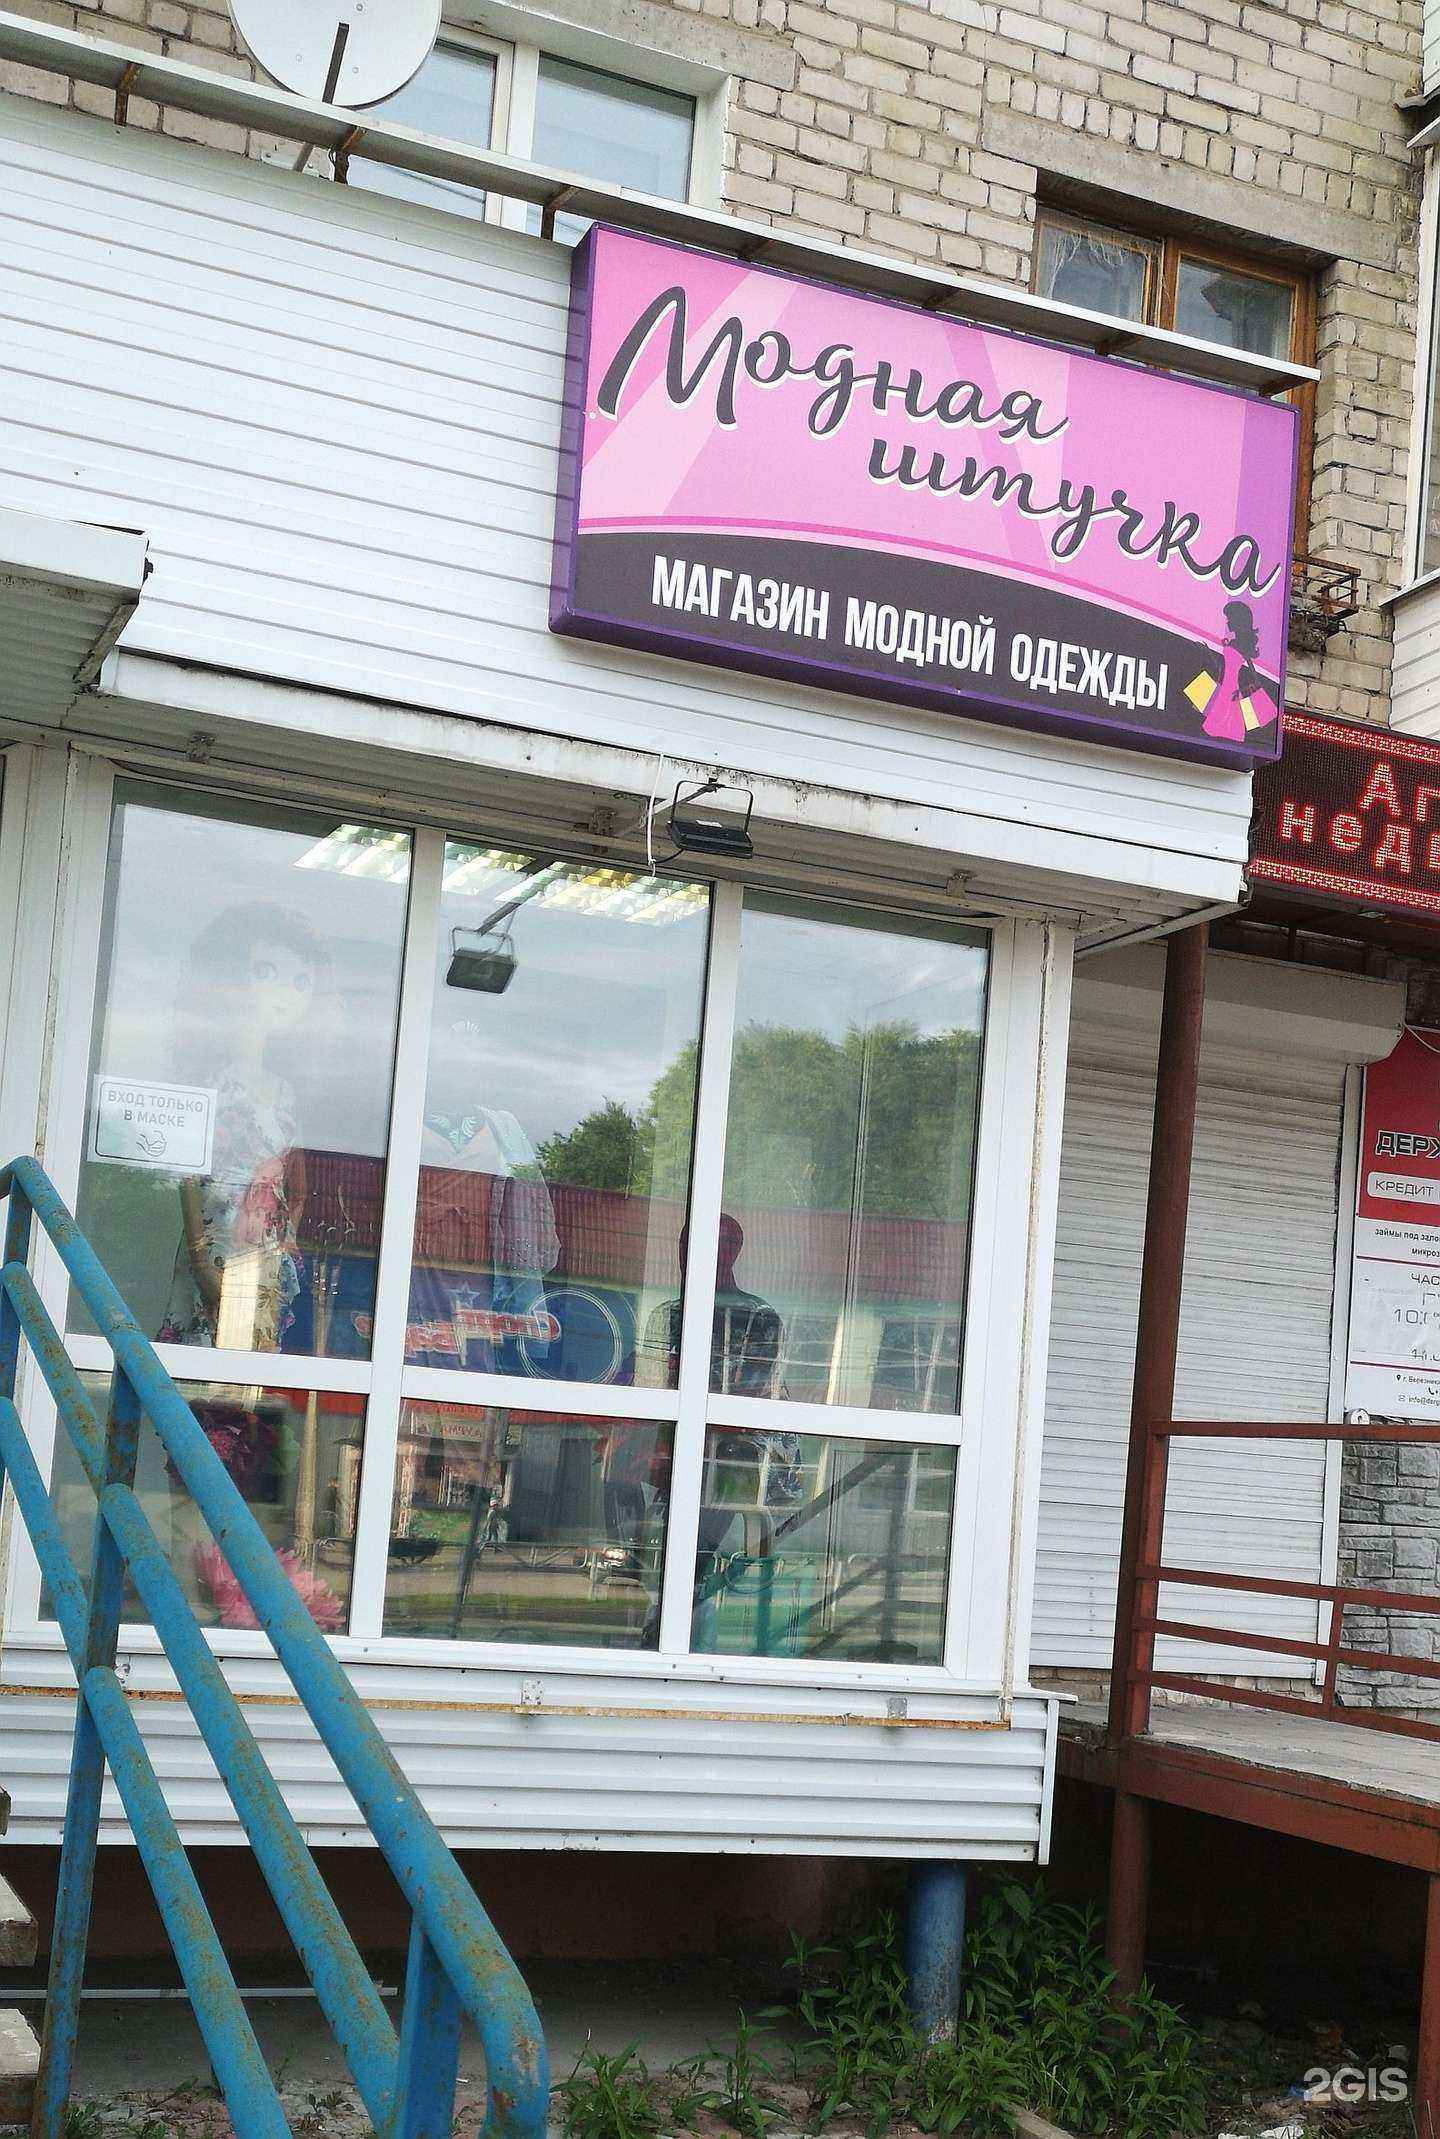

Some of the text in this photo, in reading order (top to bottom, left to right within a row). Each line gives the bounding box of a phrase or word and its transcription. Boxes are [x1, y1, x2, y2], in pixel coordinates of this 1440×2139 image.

[597, 286, 1068, 436] Модная
[867, 436, 1282, 598] штучка
[652, 555, 1169, 711] МАГАЗИН МОДНОЙ ОДЕЖДЫ
[108, 1090, 203, 1113] ВХОД ТОЛЬКО
[124, 1109, 185, 1128] В МАСКЕ
[1375, 1180, 1434, 1196] КРЕДИТ
[1374, 1227, 1440, 1243] займы под зало
